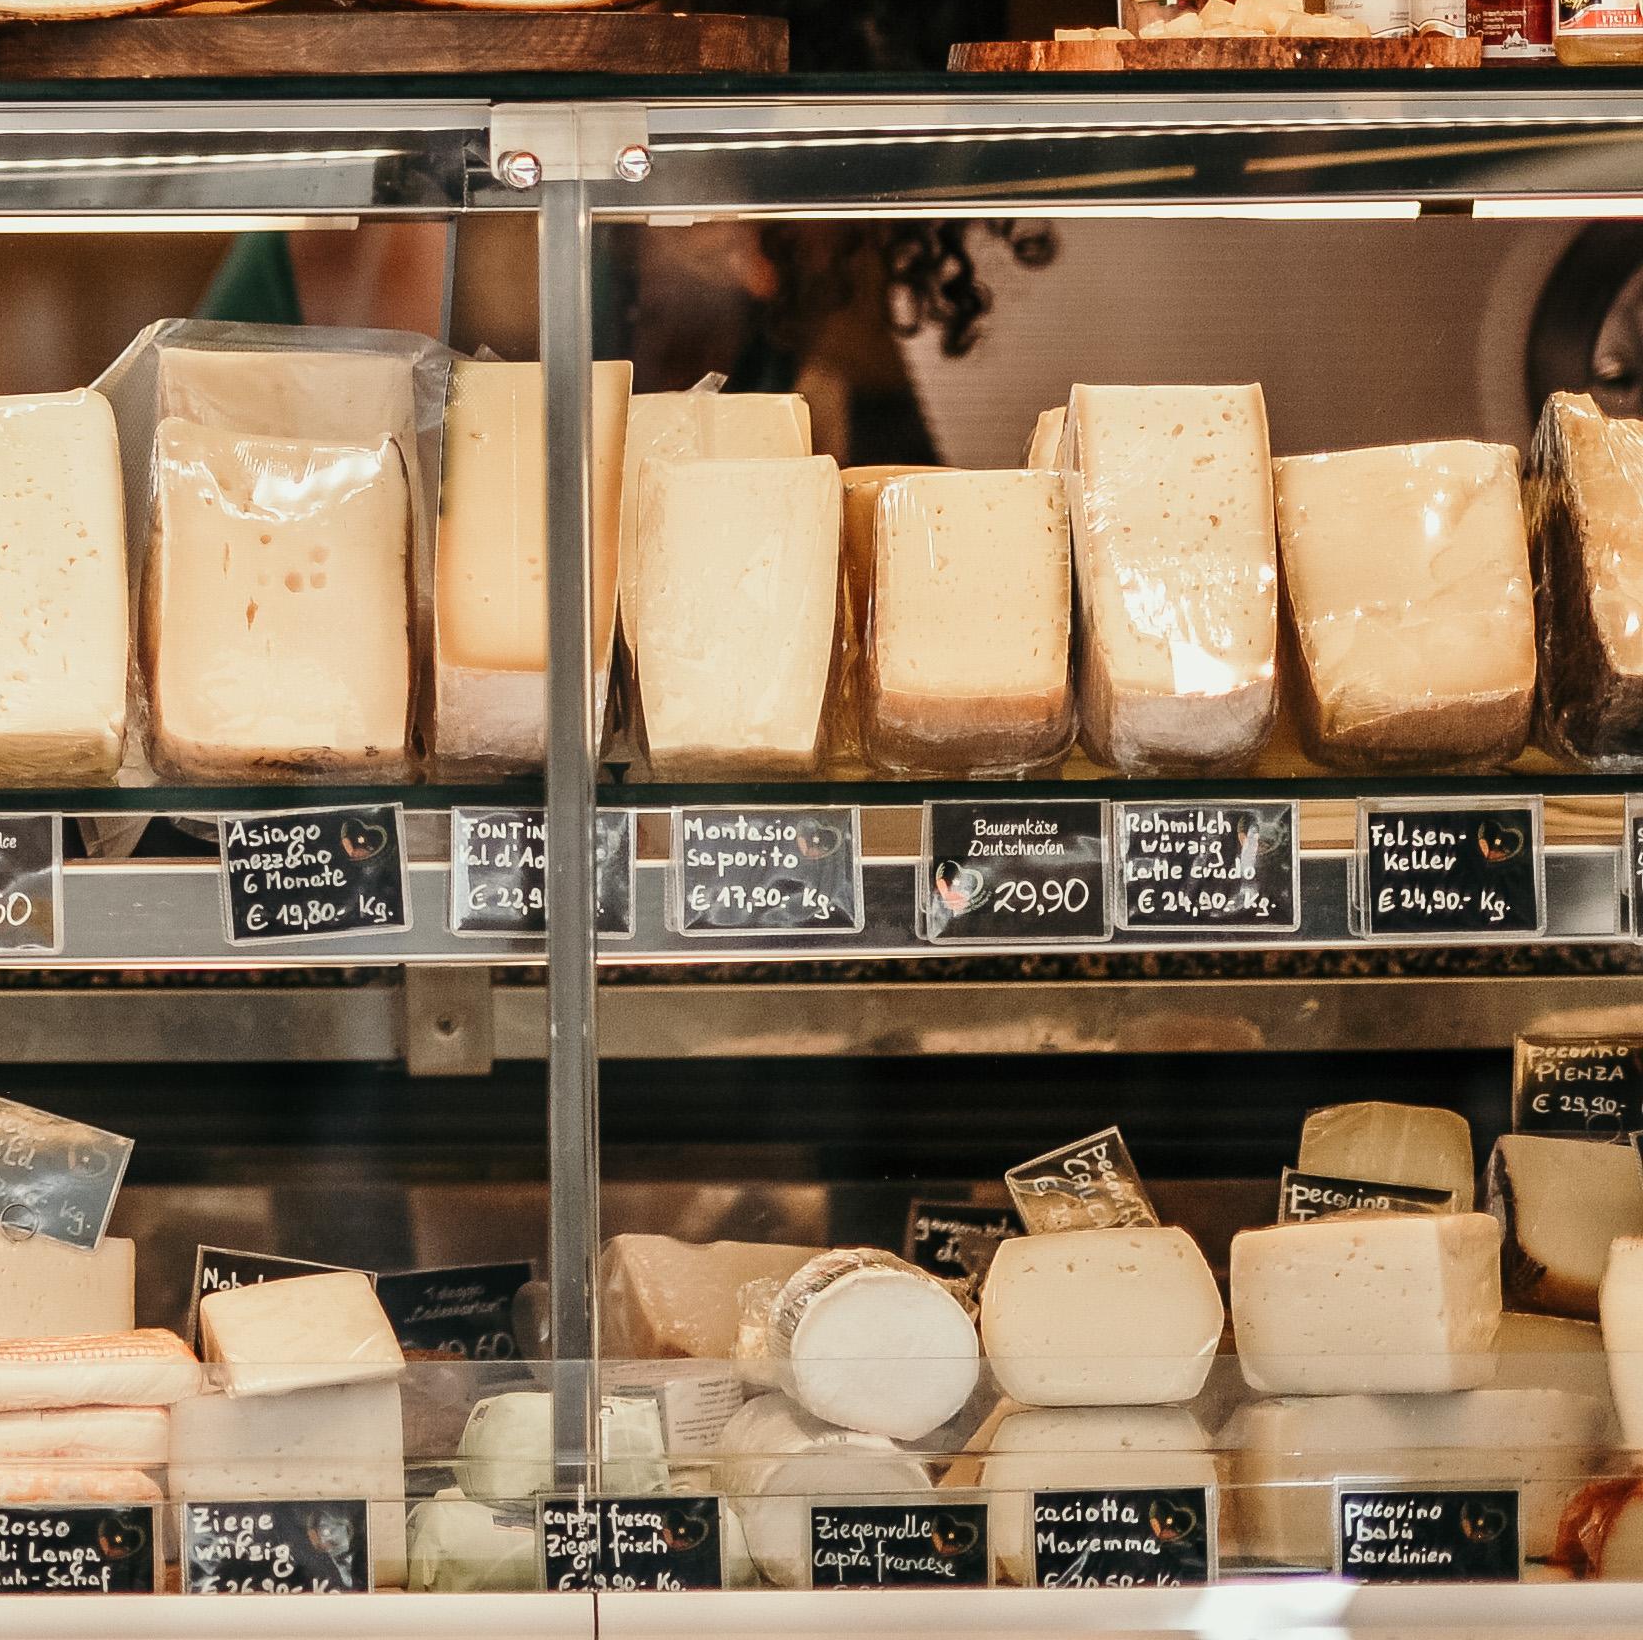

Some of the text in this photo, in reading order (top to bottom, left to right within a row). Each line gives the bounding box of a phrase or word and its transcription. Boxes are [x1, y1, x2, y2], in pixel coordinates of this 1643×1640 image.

[684, 818, 797, 842] Montasio
[973, 819, 1058, 836] Bauernkäse
[1126, 812, 1231, 834] Rohmilch
[1371, 820, 1466, 847] Felsen-
[228, 821, 321, 856] Asiago
[968, 839, 1065, 856] Deutschnofen
[229, 851, 331, 872] mezzano
[1190, 861, 1255, 880] crudo
[245, 867, 347, 893] 6 Monate
[995, 879, 1089, 915] 29,90
[1035, 1498, 1138, 1524] caciotta
[1345, 1501, 1441, 1536] pecorino
[193, 1509, 273, 1544] Ziege
[816, 1515, 931, 1548] Ziegenrolle
[609, 1531, 666, 1567] frisch
[1038, 1536, 1160, 1555] Maremma
[1348, 1544, 1451, 1564] Sardinien
[29, 1545, 101, 1574] Langa
